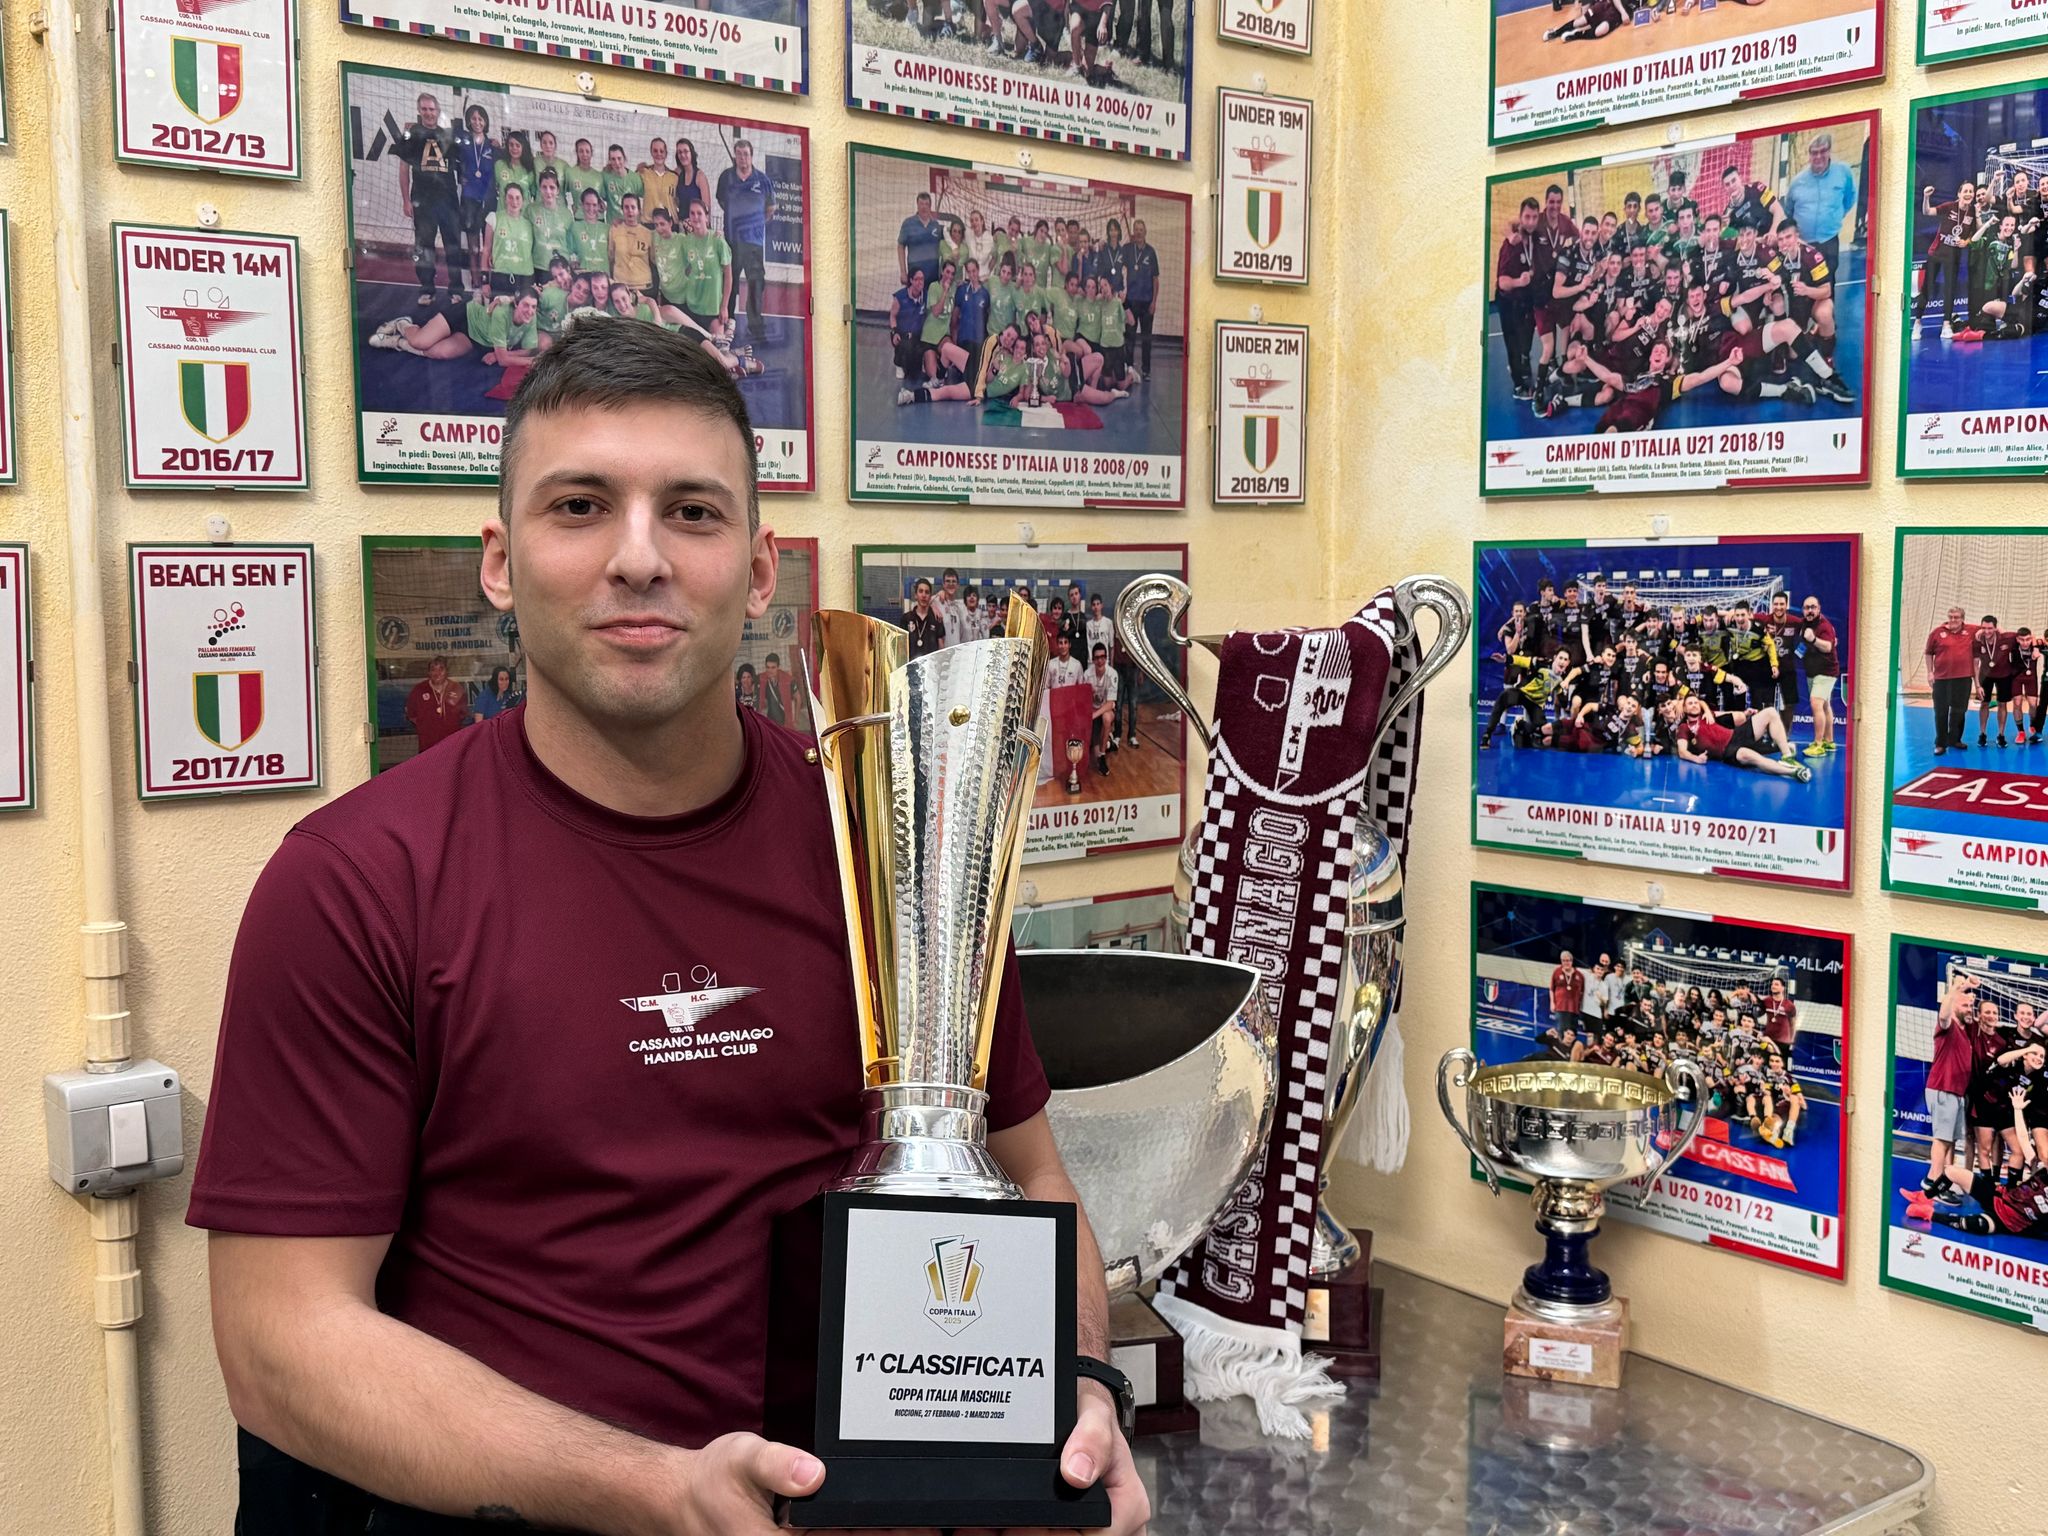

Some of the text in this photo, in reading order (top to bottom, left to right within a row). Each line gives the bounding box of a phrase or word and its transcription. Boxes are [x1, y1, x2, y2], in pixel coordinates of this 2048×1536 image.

[454, 5, 461, 14] In
[482, 10, 510, 22] Delpini,
[622, 4, 656, 29] U15
[664, 12, 742, 44] 2005/06
[140, 15, 174, 25] CASSANO
[176, 20, 213, 31] MAGNAGO
[216, 26, 251, 37] HANDBALL
[1237, 12, 1296, 40] 2018/19
[1965, 25, 1982, 35] piedi:
[504, 26, 511, 34] In
[513, 27, 536, 38] basso:
[538, 31, 559, 42] Marco
[561, 35, 598, 48] (mascotte),
[600, 41, 621, 52] Liuzzi,
[623, 44, 649, 57] Pirrone,
[1557, 34, 1797, 100] CAMPIONI D'ITALIA U17 2018/19
[894, 59, 997, 94] CAMPIONESSE
[1003, 79, 1060, 105] D'ITALIA
[1065, 90, 1090, 110] U14
[1096, 96, 1153, 122] 2006/07
[1229, 103, 1303, 130] UNDER 19M
[152, 124, 265, 158] 2012/13
[134, 245, 281, 277] UNDER 14M
[1233, 251, 1292, 272] 2018/19
[1226, 336, 1299, 356] UNDER 21M
[420, 422, 501, 444] CAMPIO
[1961, 414, 2048, 435] CAMPION
[409, 451, 430, 459] piedi:
[459, 452, 475, 461] (All),
[1546, 431, 1784, 462] CAMPIONI D'ITALIA U21 2018/19
[1936, 448, 1954, 456] piedi:
[162, 448, 274, 472] 2016/17
[373, 461, 425, 471] Inginocchiate:
[427, 463, 467, 472] Bassanese,
[897, 449, 1149, 479] CAMPIONESSE D'ITALIA U18 2008/09
[1232, 477, 1289, 494] 2018/19
[150, 563, 296, 587] BEACH SEN F
[425, 615, 480, 626] FEDERAZIONE
[434, 627, 472, 638] ITALIANA
[451, 640, 492, 650] HANDBALL
[1286, 722, 1303, 763] C.M.
[172, 754, 284, 781] 2017/18
[1053, 810, 1079, 828] U16
[1084, 804, 1138, 825] 2012/13
[1528, 805, 1597, 826] CAMPIONI
[1672, 819, 1701, 836] U19
[1708, 822, 1776, 846] 2020/21
[1962, 842, 2048, 868] CAMPION
[1966, 869, 1984, 878] piedi:
[1986, 872, 2009, 881] Petazzi
[2011, 875, 2028, 884] (Dir),
[1226, 806, 1310, 1020] GNAGO
[691, 994, 709, 1003] H.C.
[629, 1027, 774, 1052] CASSANO MAGNAGO
[644, 1043, 758, 1065] HANDBALL CLUB
[1669, 1181, 1698, 1202] U20
[1705, 1190, 1773, 1222] 2021/22
[1202, 1143, 1268, 1303] CASS
[1956, 1276, 1974, 1286] piedi:
[929, 1308, 953, 1316] COPPA
[880, 1353, 1045, 1378] CLASSIFICATA
[889, 1388, 1012, 1403] COPPA ITALIA MASCHILE
[894, 1409, 923, 1418] RICCIONE,
[932, 1410, 960, 1418] FEBBRAIO
